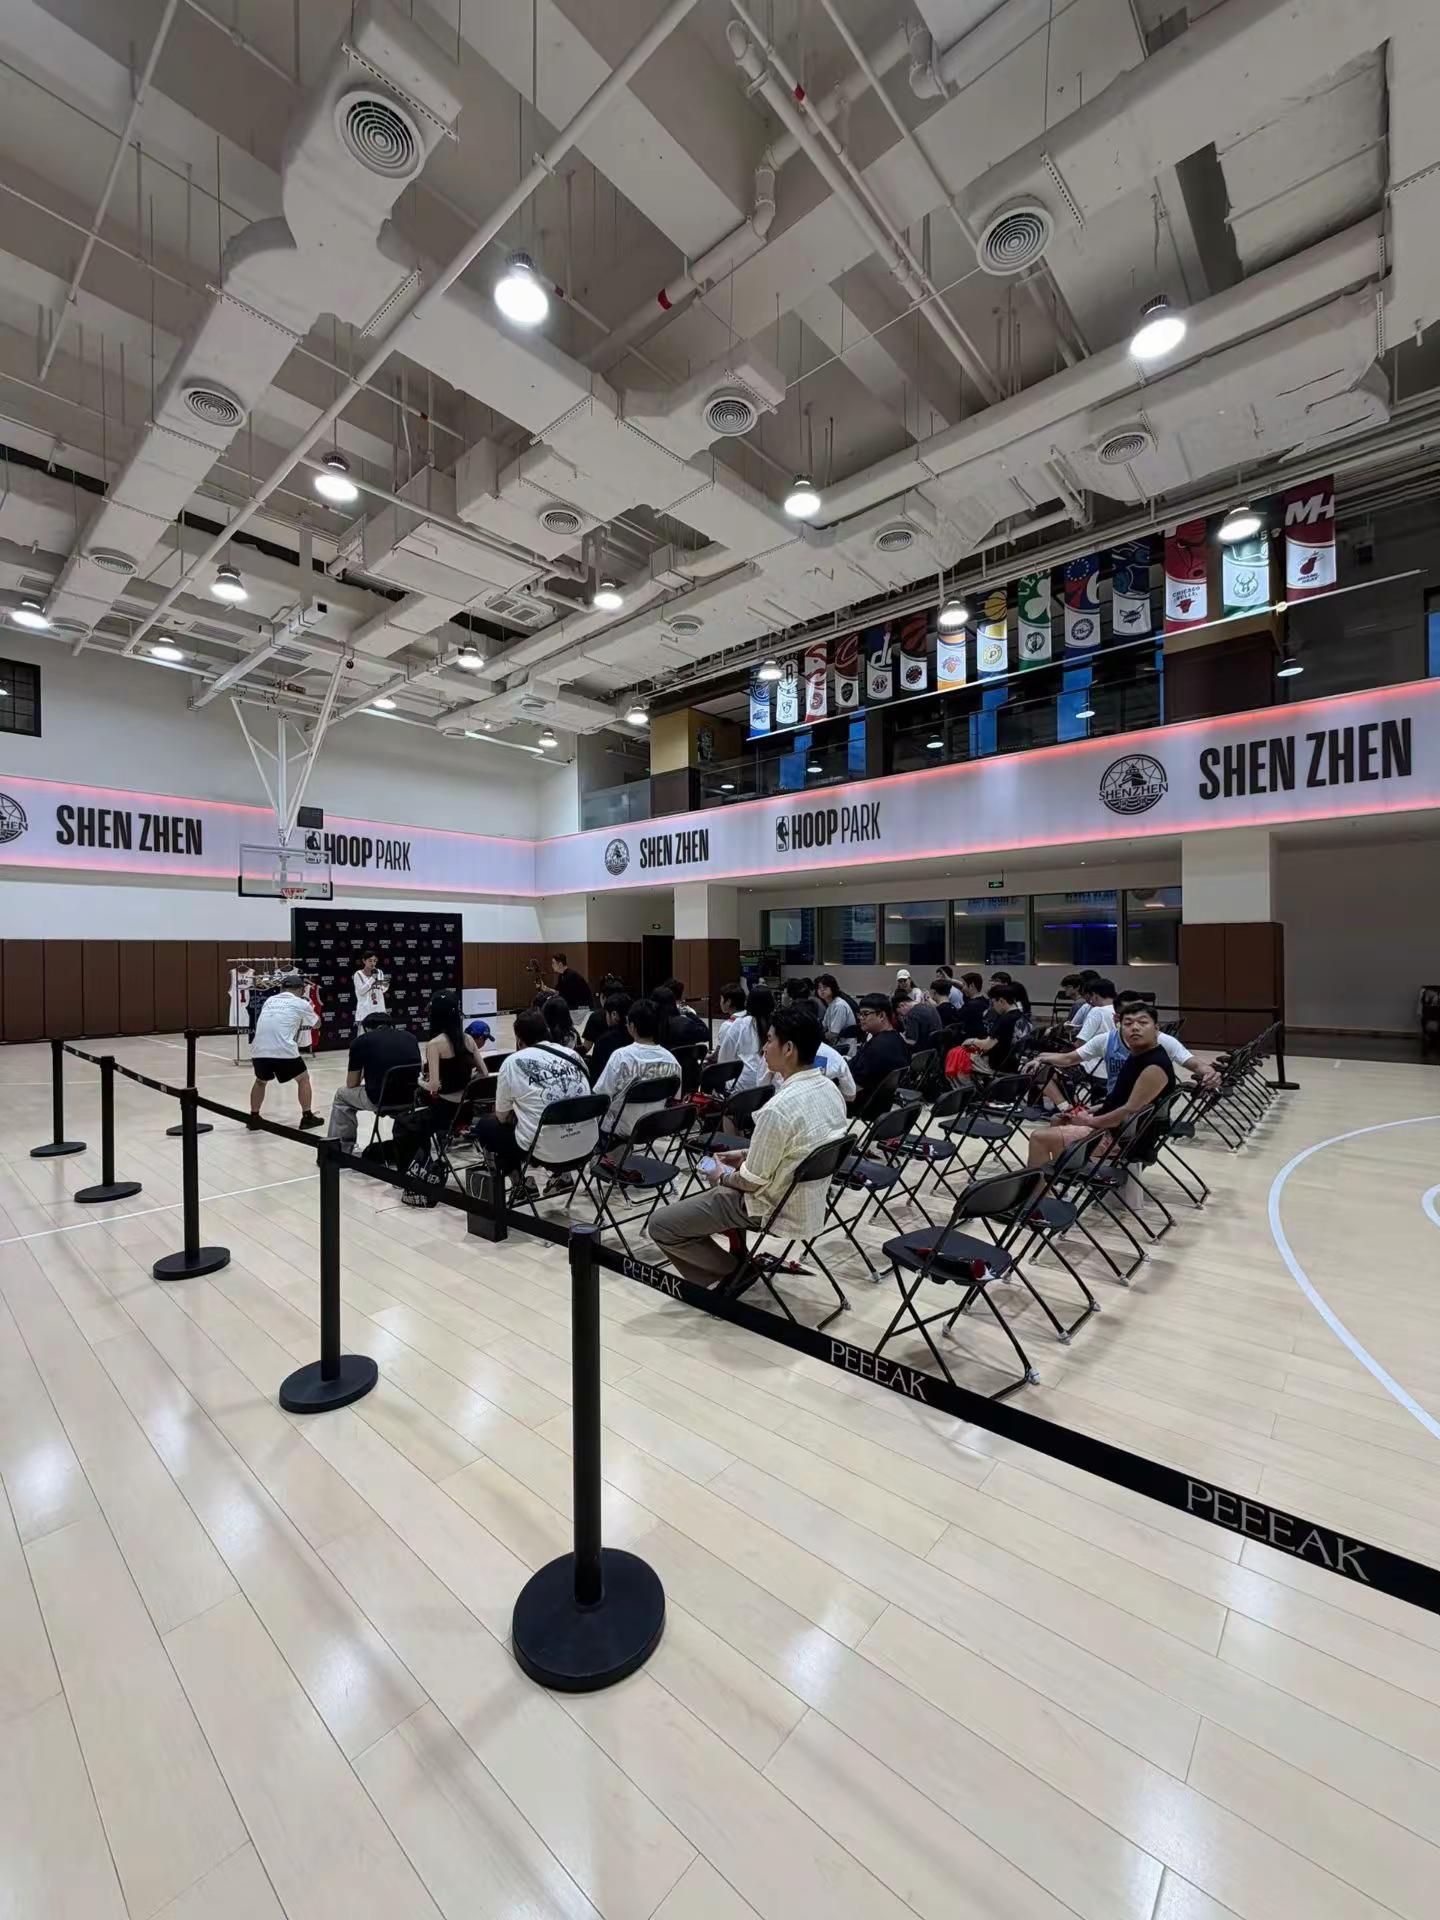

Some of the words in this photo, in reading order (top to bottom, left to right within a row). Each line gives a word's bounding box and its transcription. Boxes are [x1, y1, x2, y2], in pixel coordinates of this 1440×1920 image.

[1199, 735, 1296, 801] SHEN
[1306, 717, 1412, 788] ZHEN
[1099, 782, 1169, 801] SHENZHEN
[56, 804, 132, 850] SHEN
[139, 814, 203, 856] ZHEN
[639, 834, 673, 869] SHEN
[675, 828, 709, 865] ZHEN
[791, 808, 838, 850] HOOP
[841, 802, 881, 844] PARK
[323, 832, 373, 868] HOOP
[376, 839, 411, 872] PARK
[622, 1257, 683, 1299] PEEEAK
[829, 1340, 928, 1402] PEEEAK
[1186, 1479, 1371, 1582] PEEEAK
